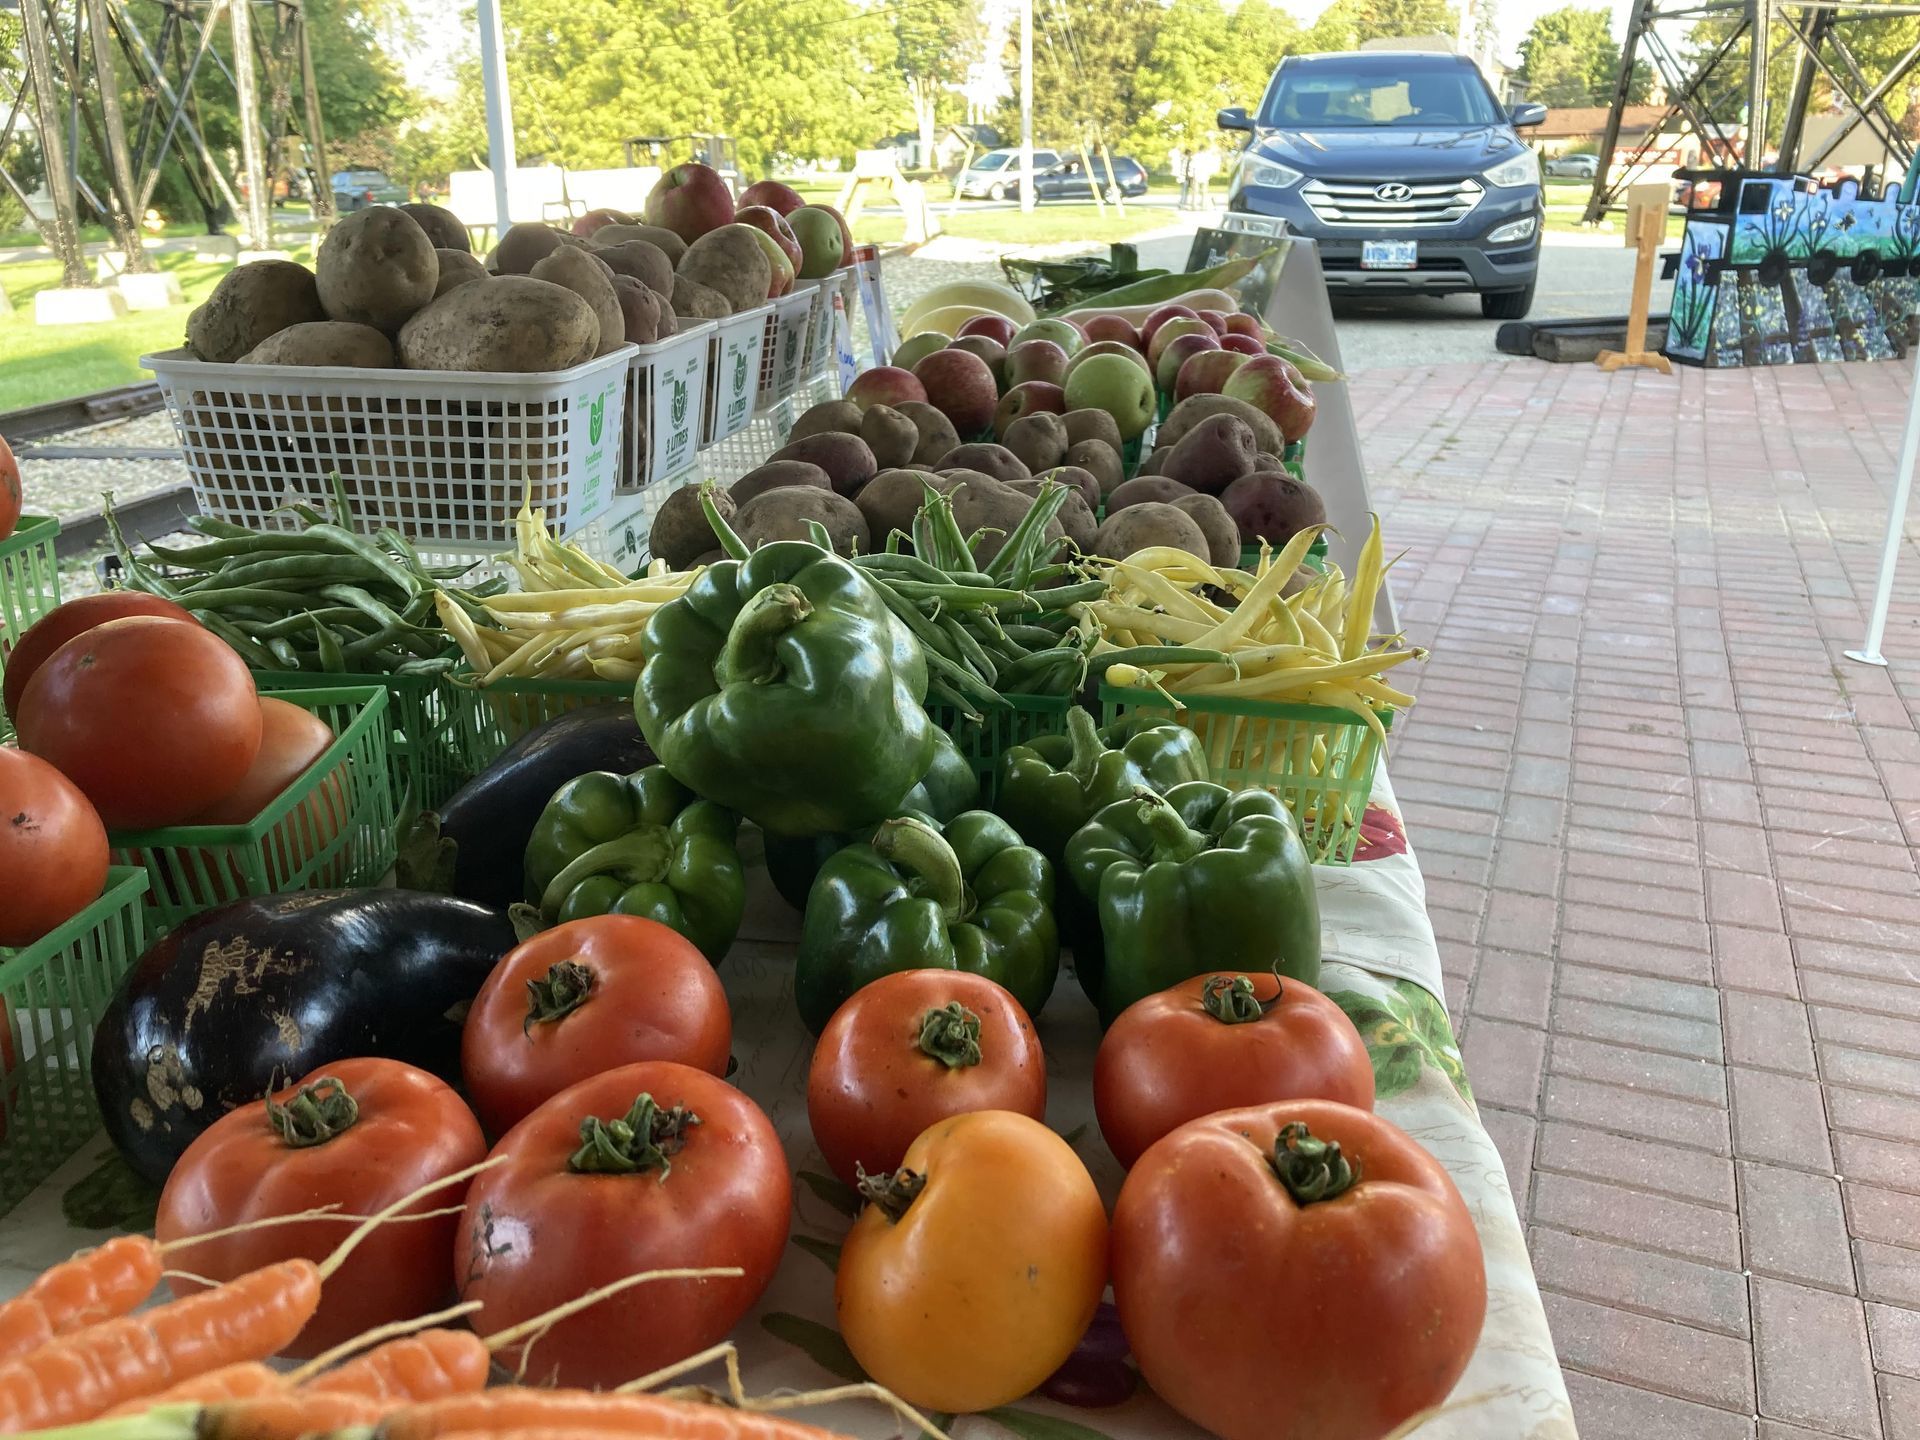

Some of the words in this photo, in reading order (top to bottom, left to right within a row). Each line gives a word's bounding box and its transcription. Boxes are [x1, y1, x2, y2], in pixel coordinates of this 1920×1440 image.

[727, 403, 732, 418] 3
[731, 396, 747, 417] LITRES
[665, 438, 671, 455] 3
[670, 427, 689, 453] LITRES
[586, 474, 601, 493] LITRES
